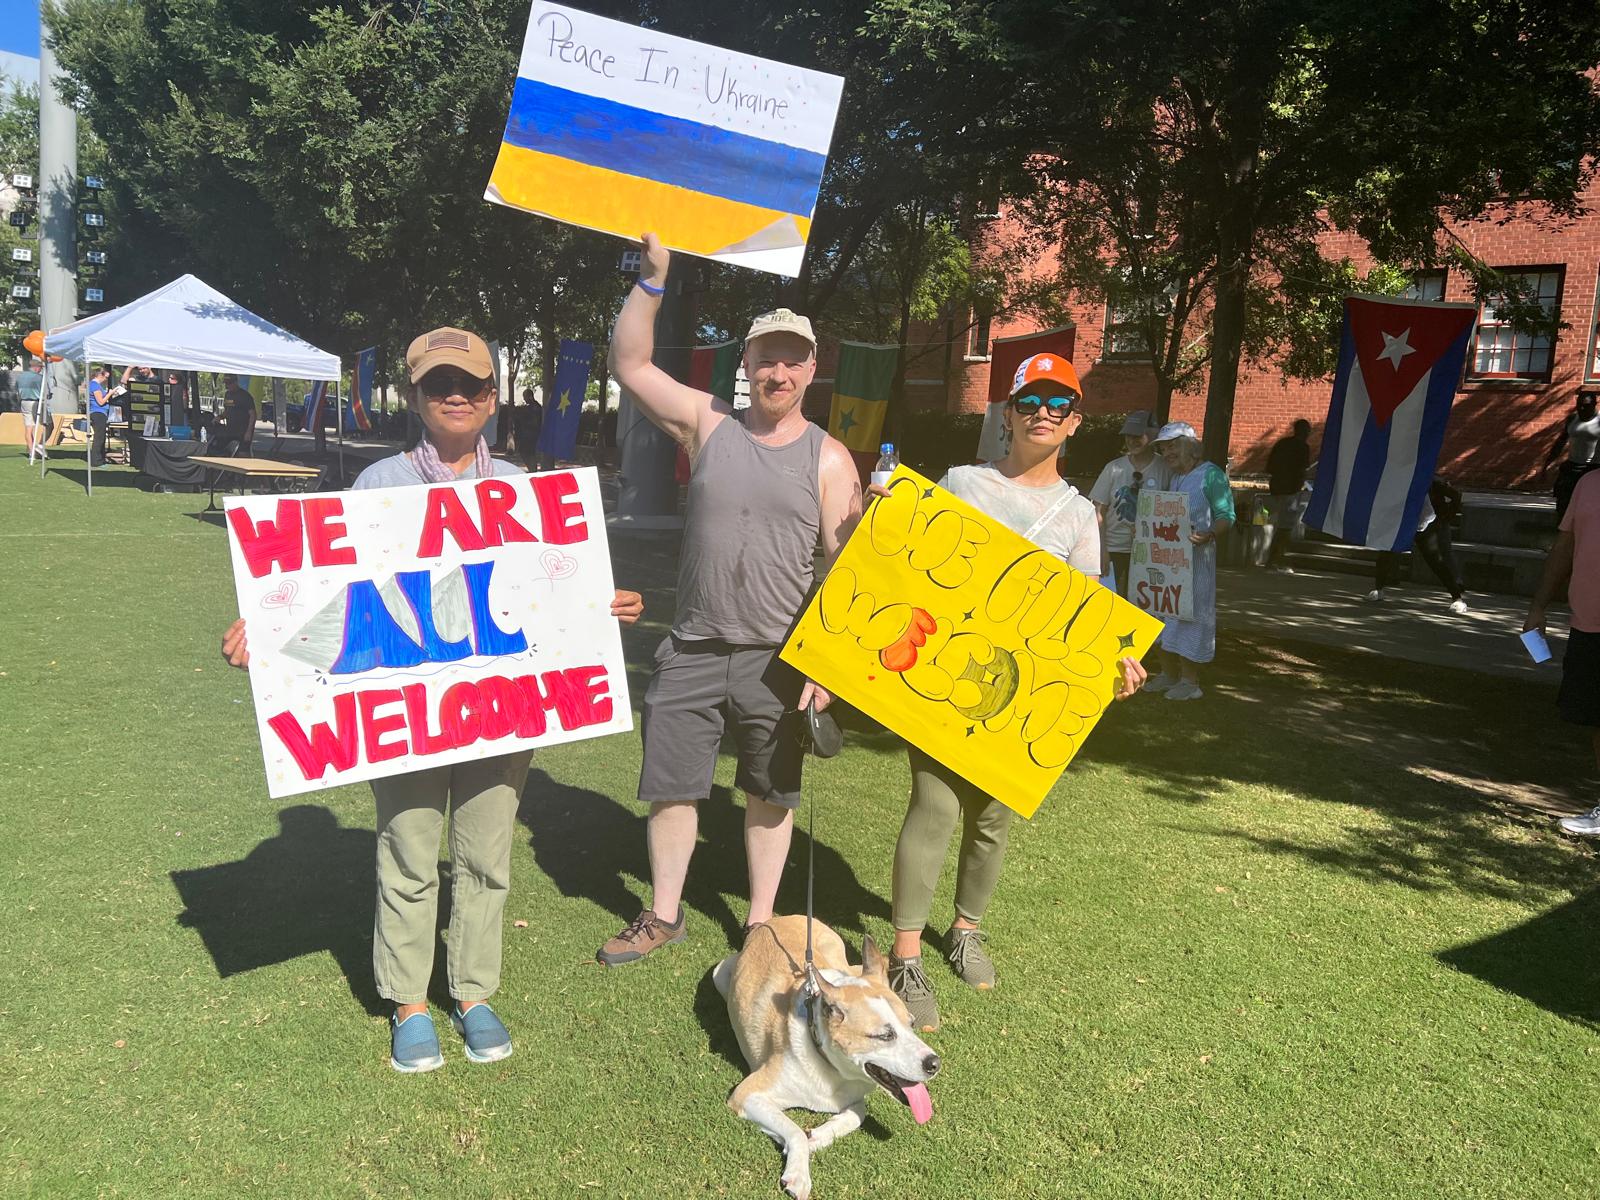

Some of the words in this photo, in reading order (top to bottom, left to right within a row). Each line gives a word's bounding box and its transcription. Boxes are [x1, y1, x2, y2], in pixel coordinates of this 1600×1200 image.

[537, 12, 616, 79] Peace
[635, 47, 679, 88] In
[704, 64, 789, 119] Ukraine
[228, 498, 357, 578] WE
[417, 472, 589, 558] ARE
[871, 477, 990, 589] WE
[329, 560, 529, 674] ALL
[1137, 581, 1182, 615] STAY
[267, 665, 612, 780] WELCOME
[820, 567, 1101, 768] WELCOME
